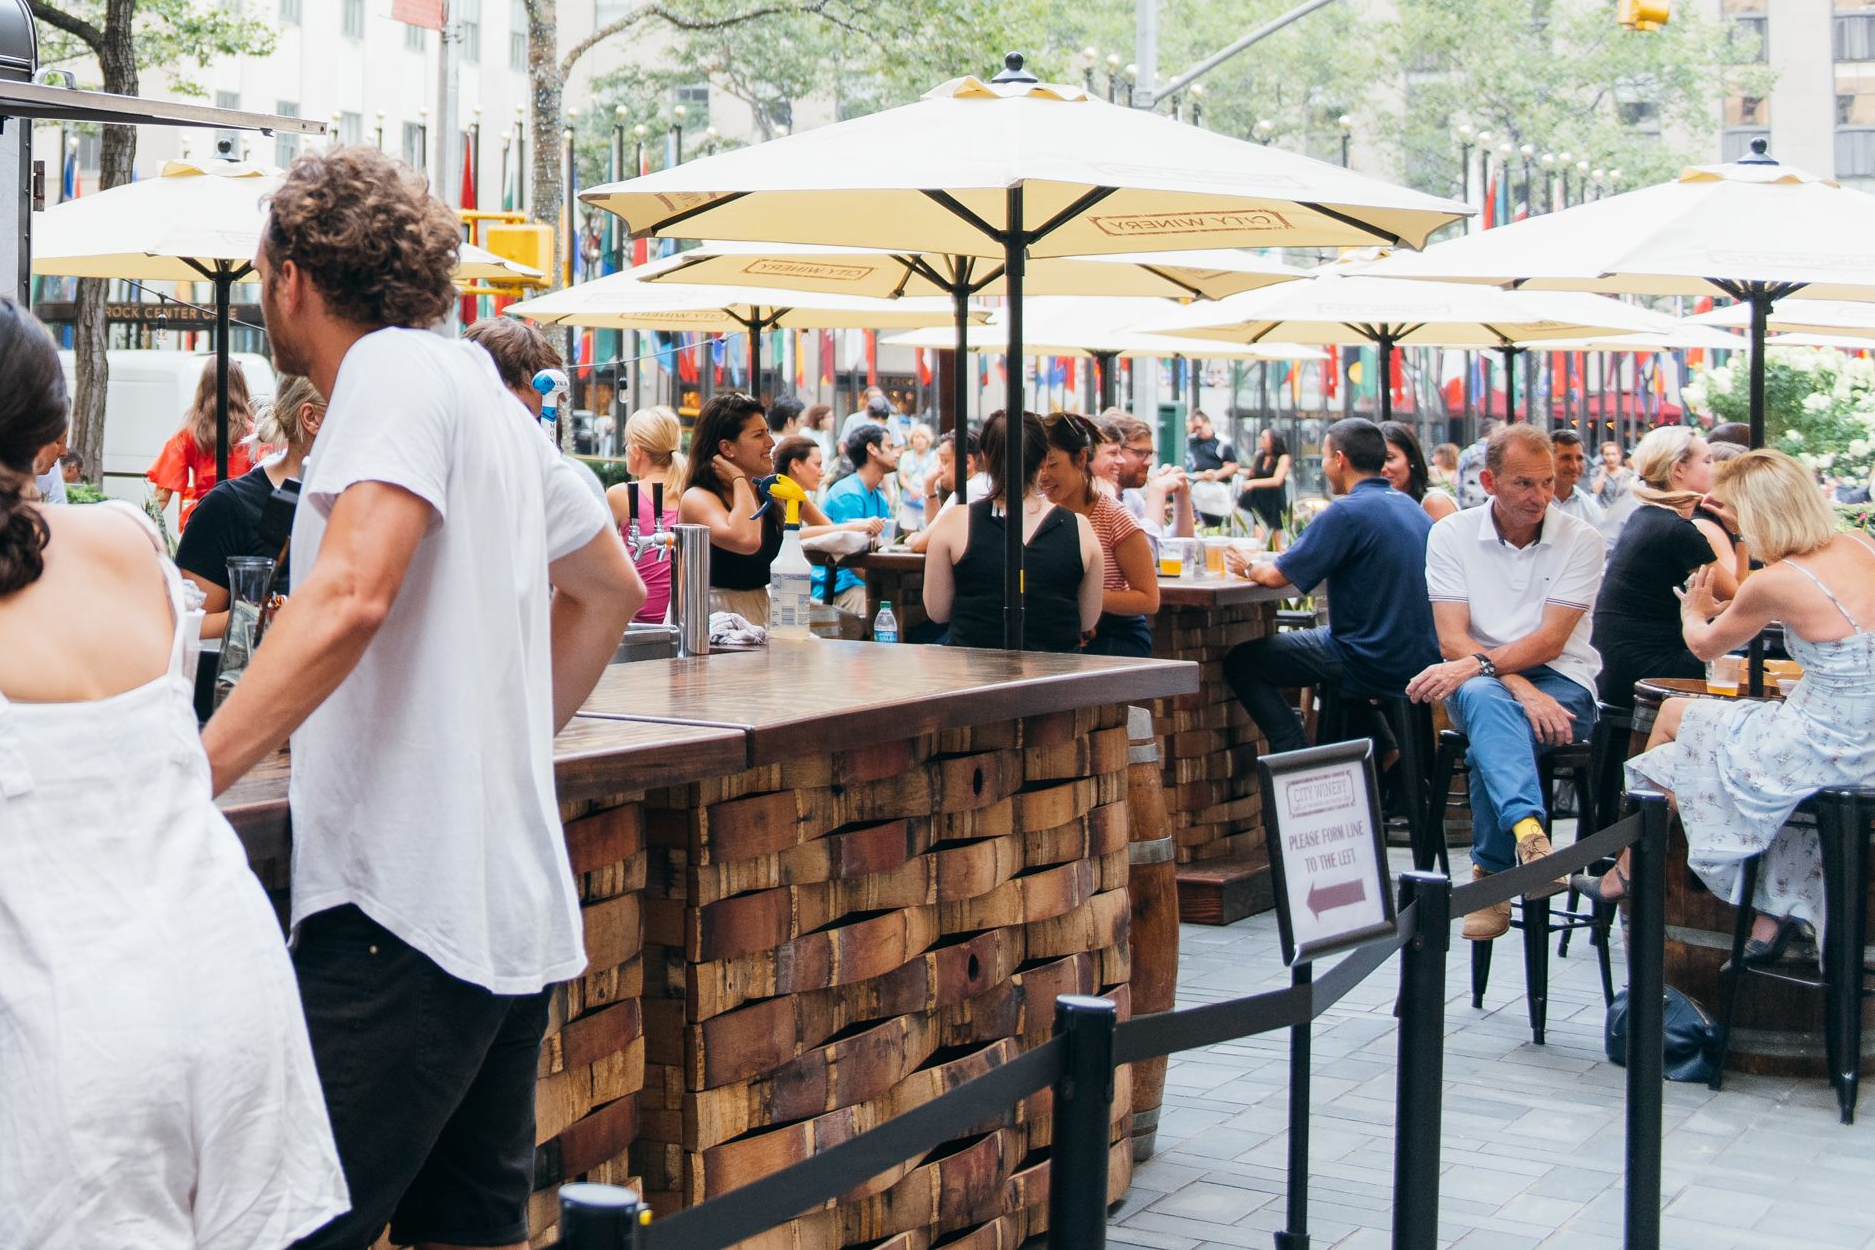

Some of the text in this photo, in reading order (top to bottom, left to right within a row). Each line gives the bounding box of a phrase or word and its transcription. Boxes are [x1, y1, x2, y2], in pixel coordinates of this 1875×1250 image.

[144, 308, 196, 319] CENTER
[202, 308, 238, 319] CAE
[1293, 779, 1347, 803] CITY WINERY
[1289, 820, 1364, 851] PLEASE FORM LINE
[1304, 848, 1356, 873] TO THE LEFT
